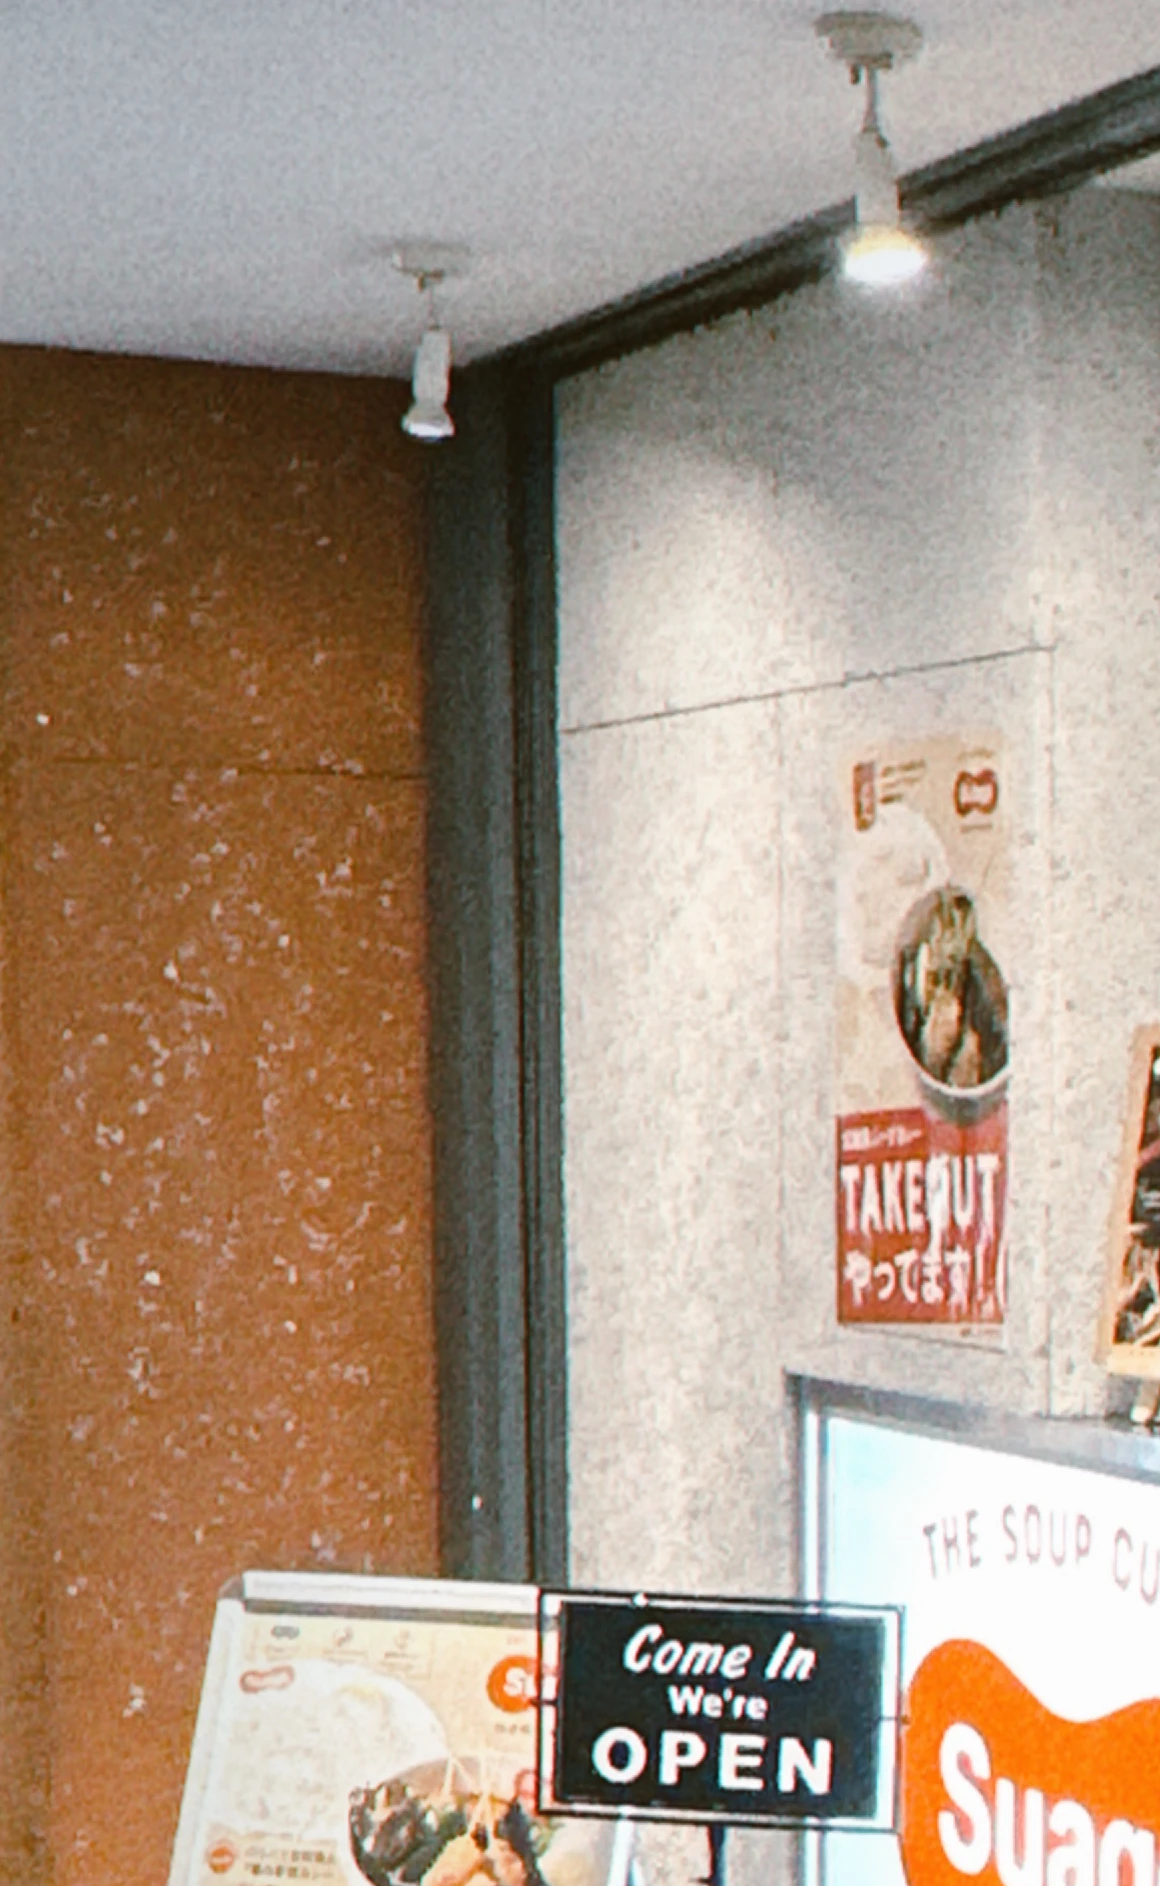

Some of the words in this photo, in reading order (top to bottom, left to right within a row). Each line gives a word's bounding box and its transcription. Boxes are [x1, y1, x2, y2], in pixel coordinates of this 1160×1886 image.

[922, 1508, 982, 1580] THE
[1002, 1503, 1092, 1568] SOUP
[623, 1623, 752, 1680] Come
[764, 1630, 818, 1682] In
[667, 1684, 769, 1720] We're
[592, 1726, 833, 1795] OPEN
